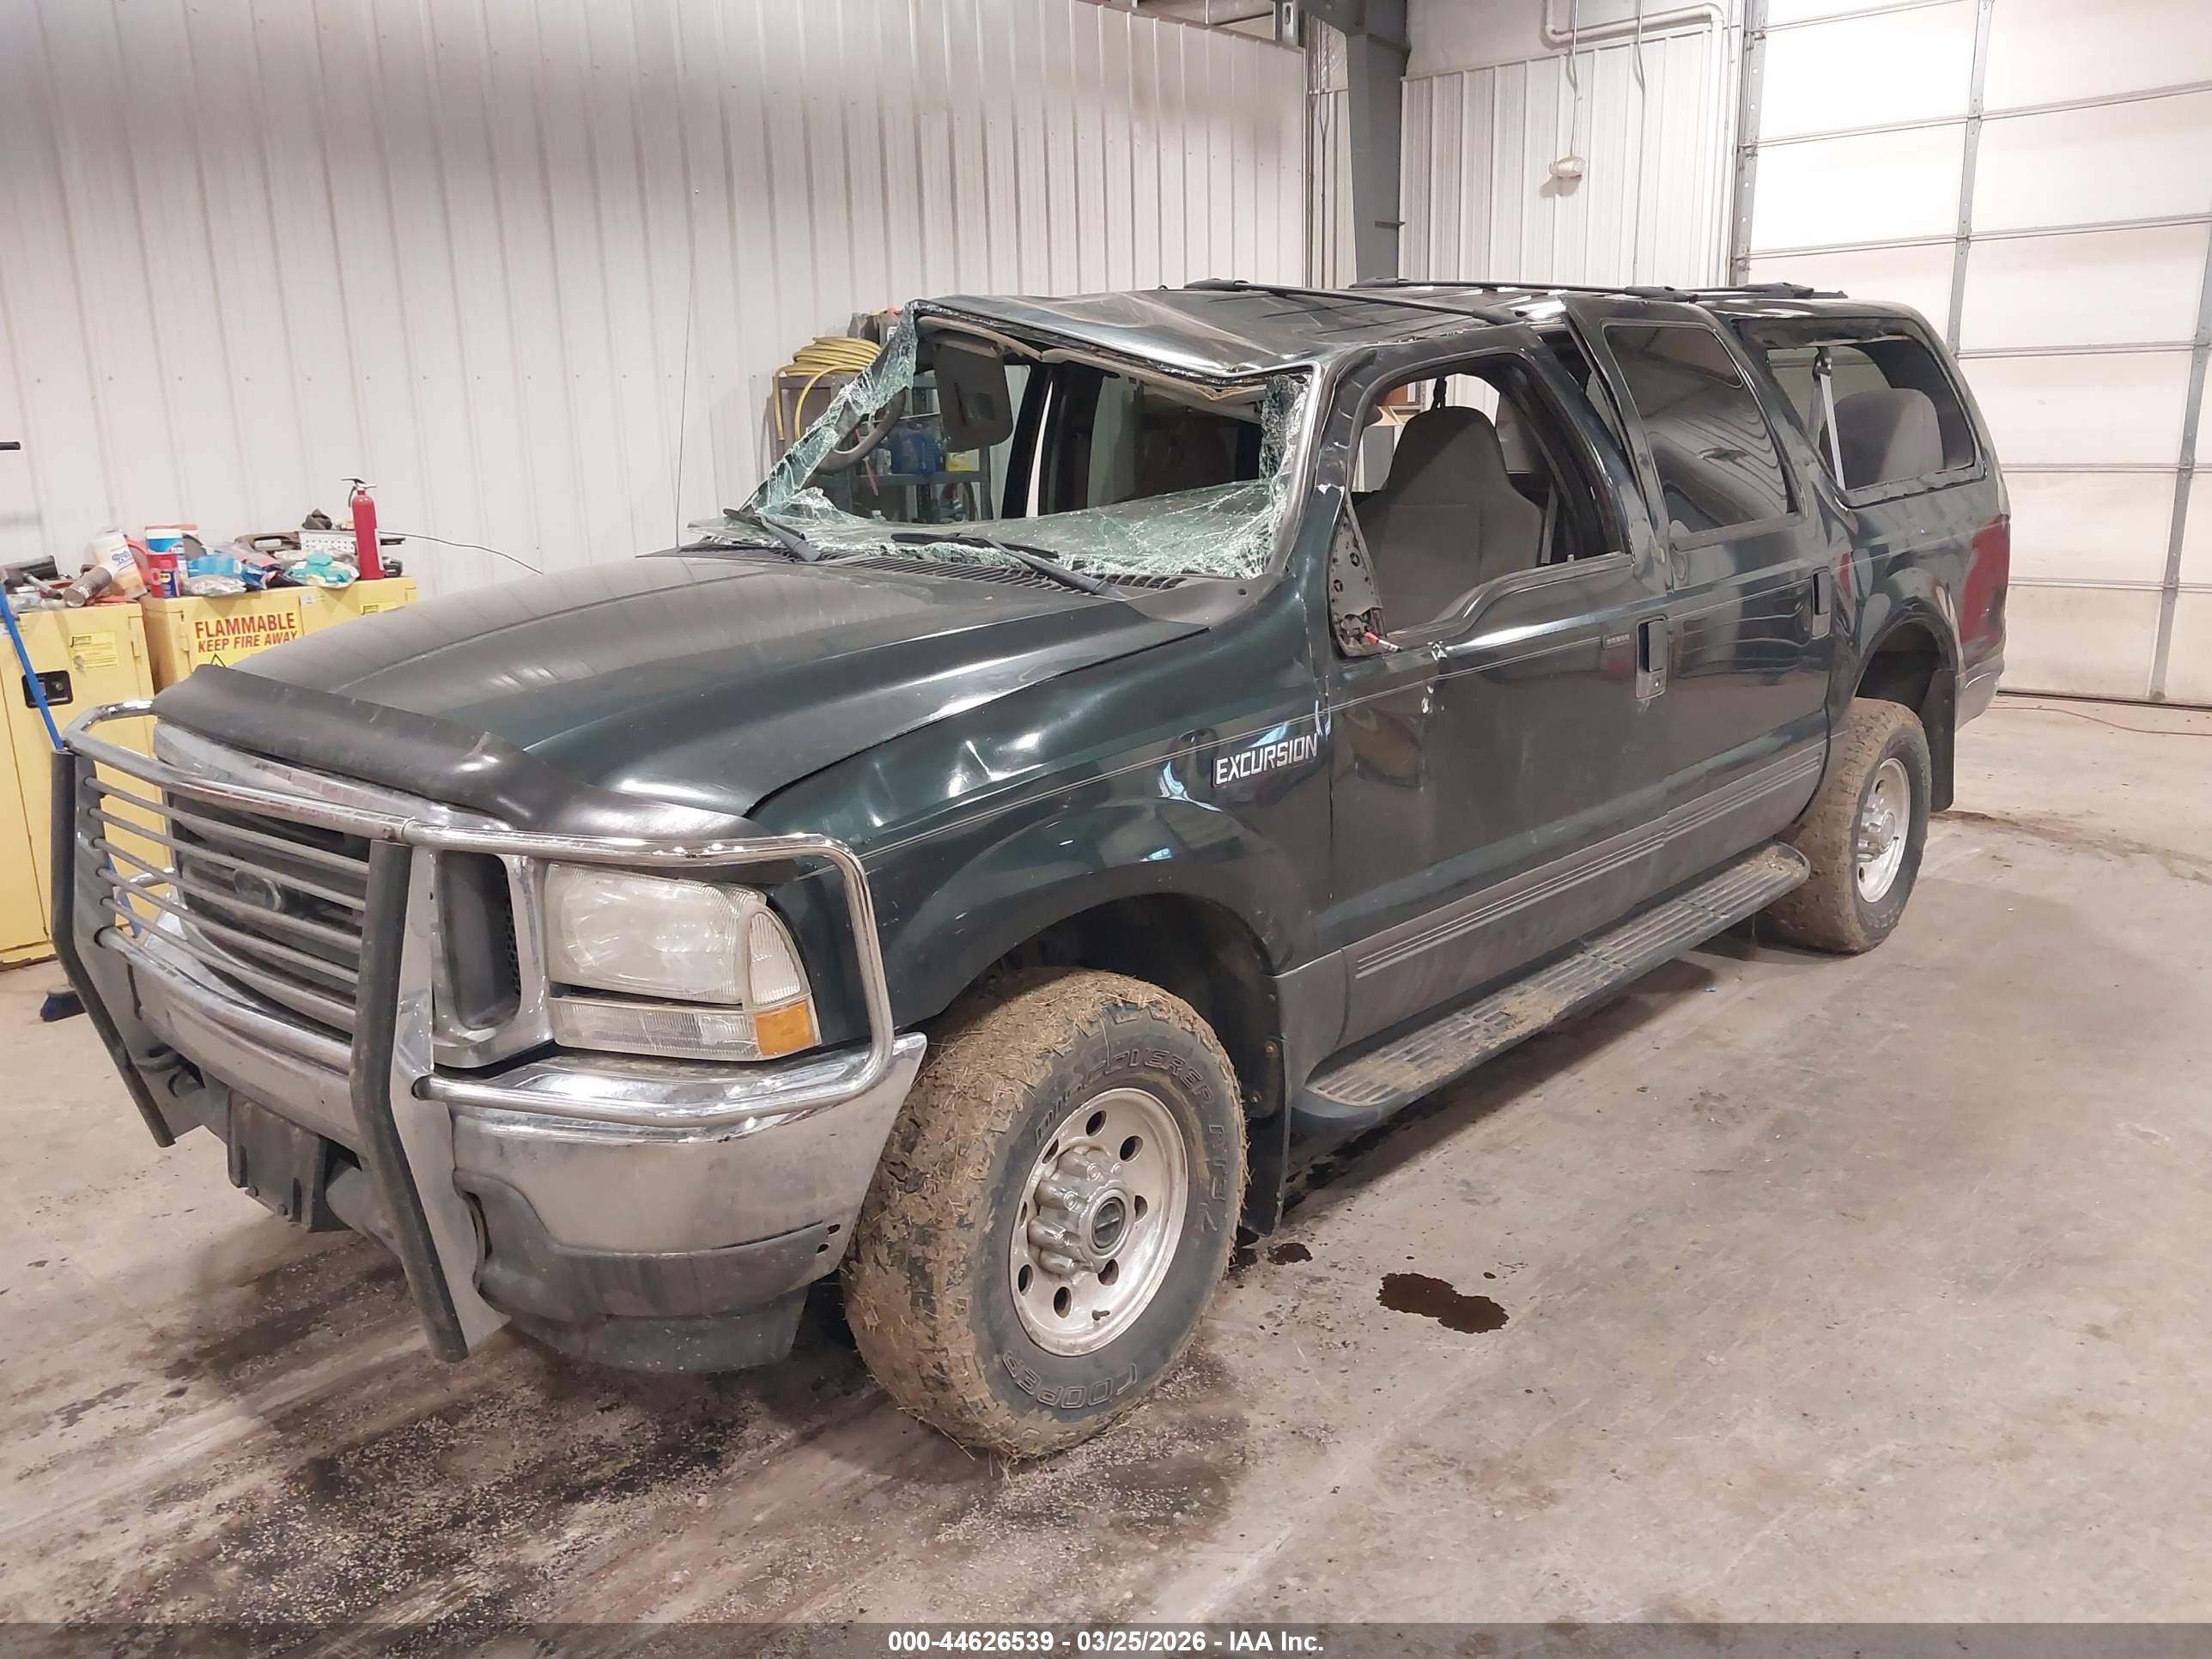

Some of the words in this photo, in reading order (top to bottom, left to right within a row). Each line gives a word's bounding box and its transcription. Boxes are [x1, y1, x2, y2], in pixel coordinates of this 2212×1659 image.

[194, 612, 296, 639] FLAMMABLE
[198, 638, 230, 653] KEEP
[233, 634, 261, 649] FIRE
[264, 629, 298, 646] AWAY
[1215, 732, 1318, 785] EXCURSION
[1002, 1350, 1138, 1409] COOPER
